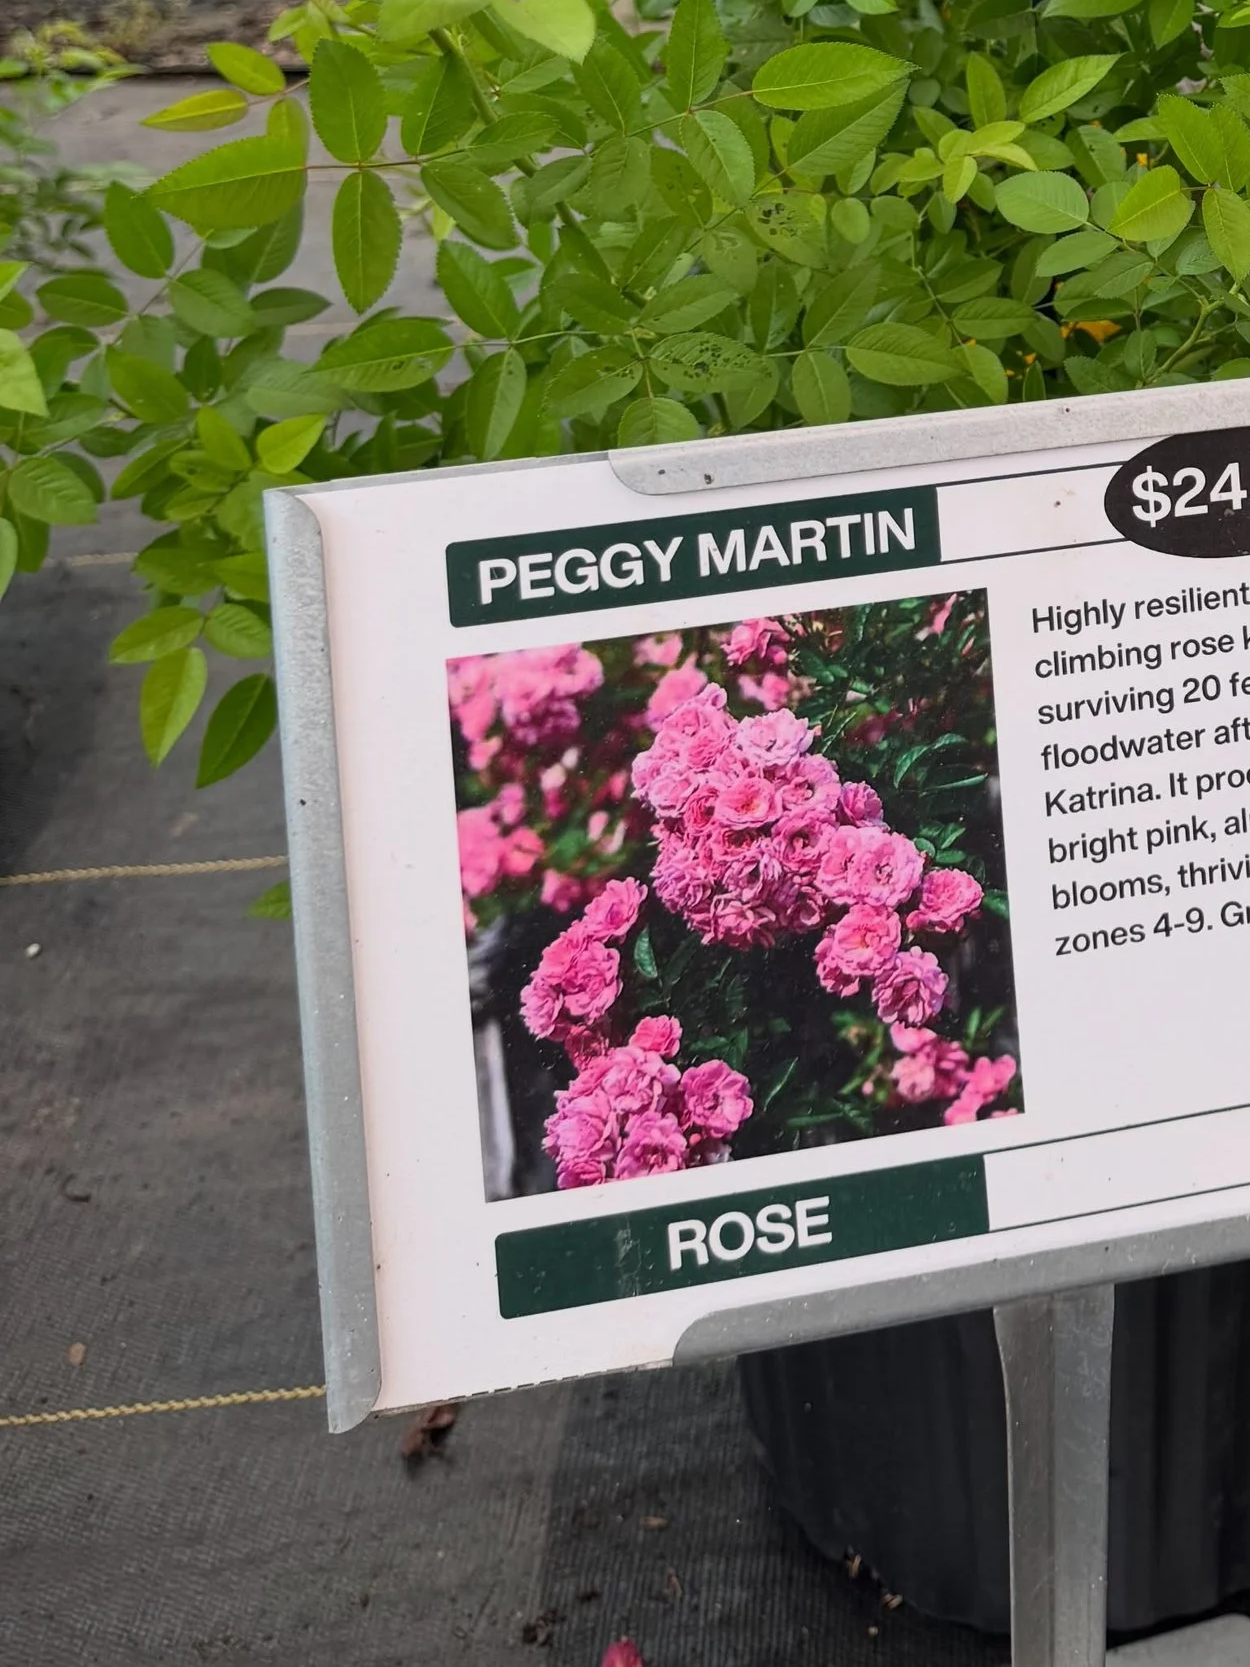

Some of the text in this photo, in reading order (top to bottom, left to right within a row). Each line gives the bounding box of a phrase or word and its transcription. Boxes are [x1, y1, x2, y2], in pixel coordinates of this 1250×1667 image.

[478, 507, 916, 605] PEGGY MARTIN
[1032, 598, 1126, 636] Highly
[1034, 642, 1162, 679] climbing
[1170, 634, 1235, 660] rose
[1037, 686, 1175, 725] surviving
[1182, 674, 1221, 704] 20
[1040, 728, 1206, 771] floodwater
[1045, 781, 1162, 817] Katrina.
[1169, 772, 1189, 798] It
[1048, 826, 1139, 864] bright
[1146, 815, 1217, 855] pink,
[1051, 874, 1171, 910] blooms,
[1055, 923, 1146, 957] zones
[1153, 906, 1213, 938] 4-9.
[667, 1195, 833, 1270] ROSE
